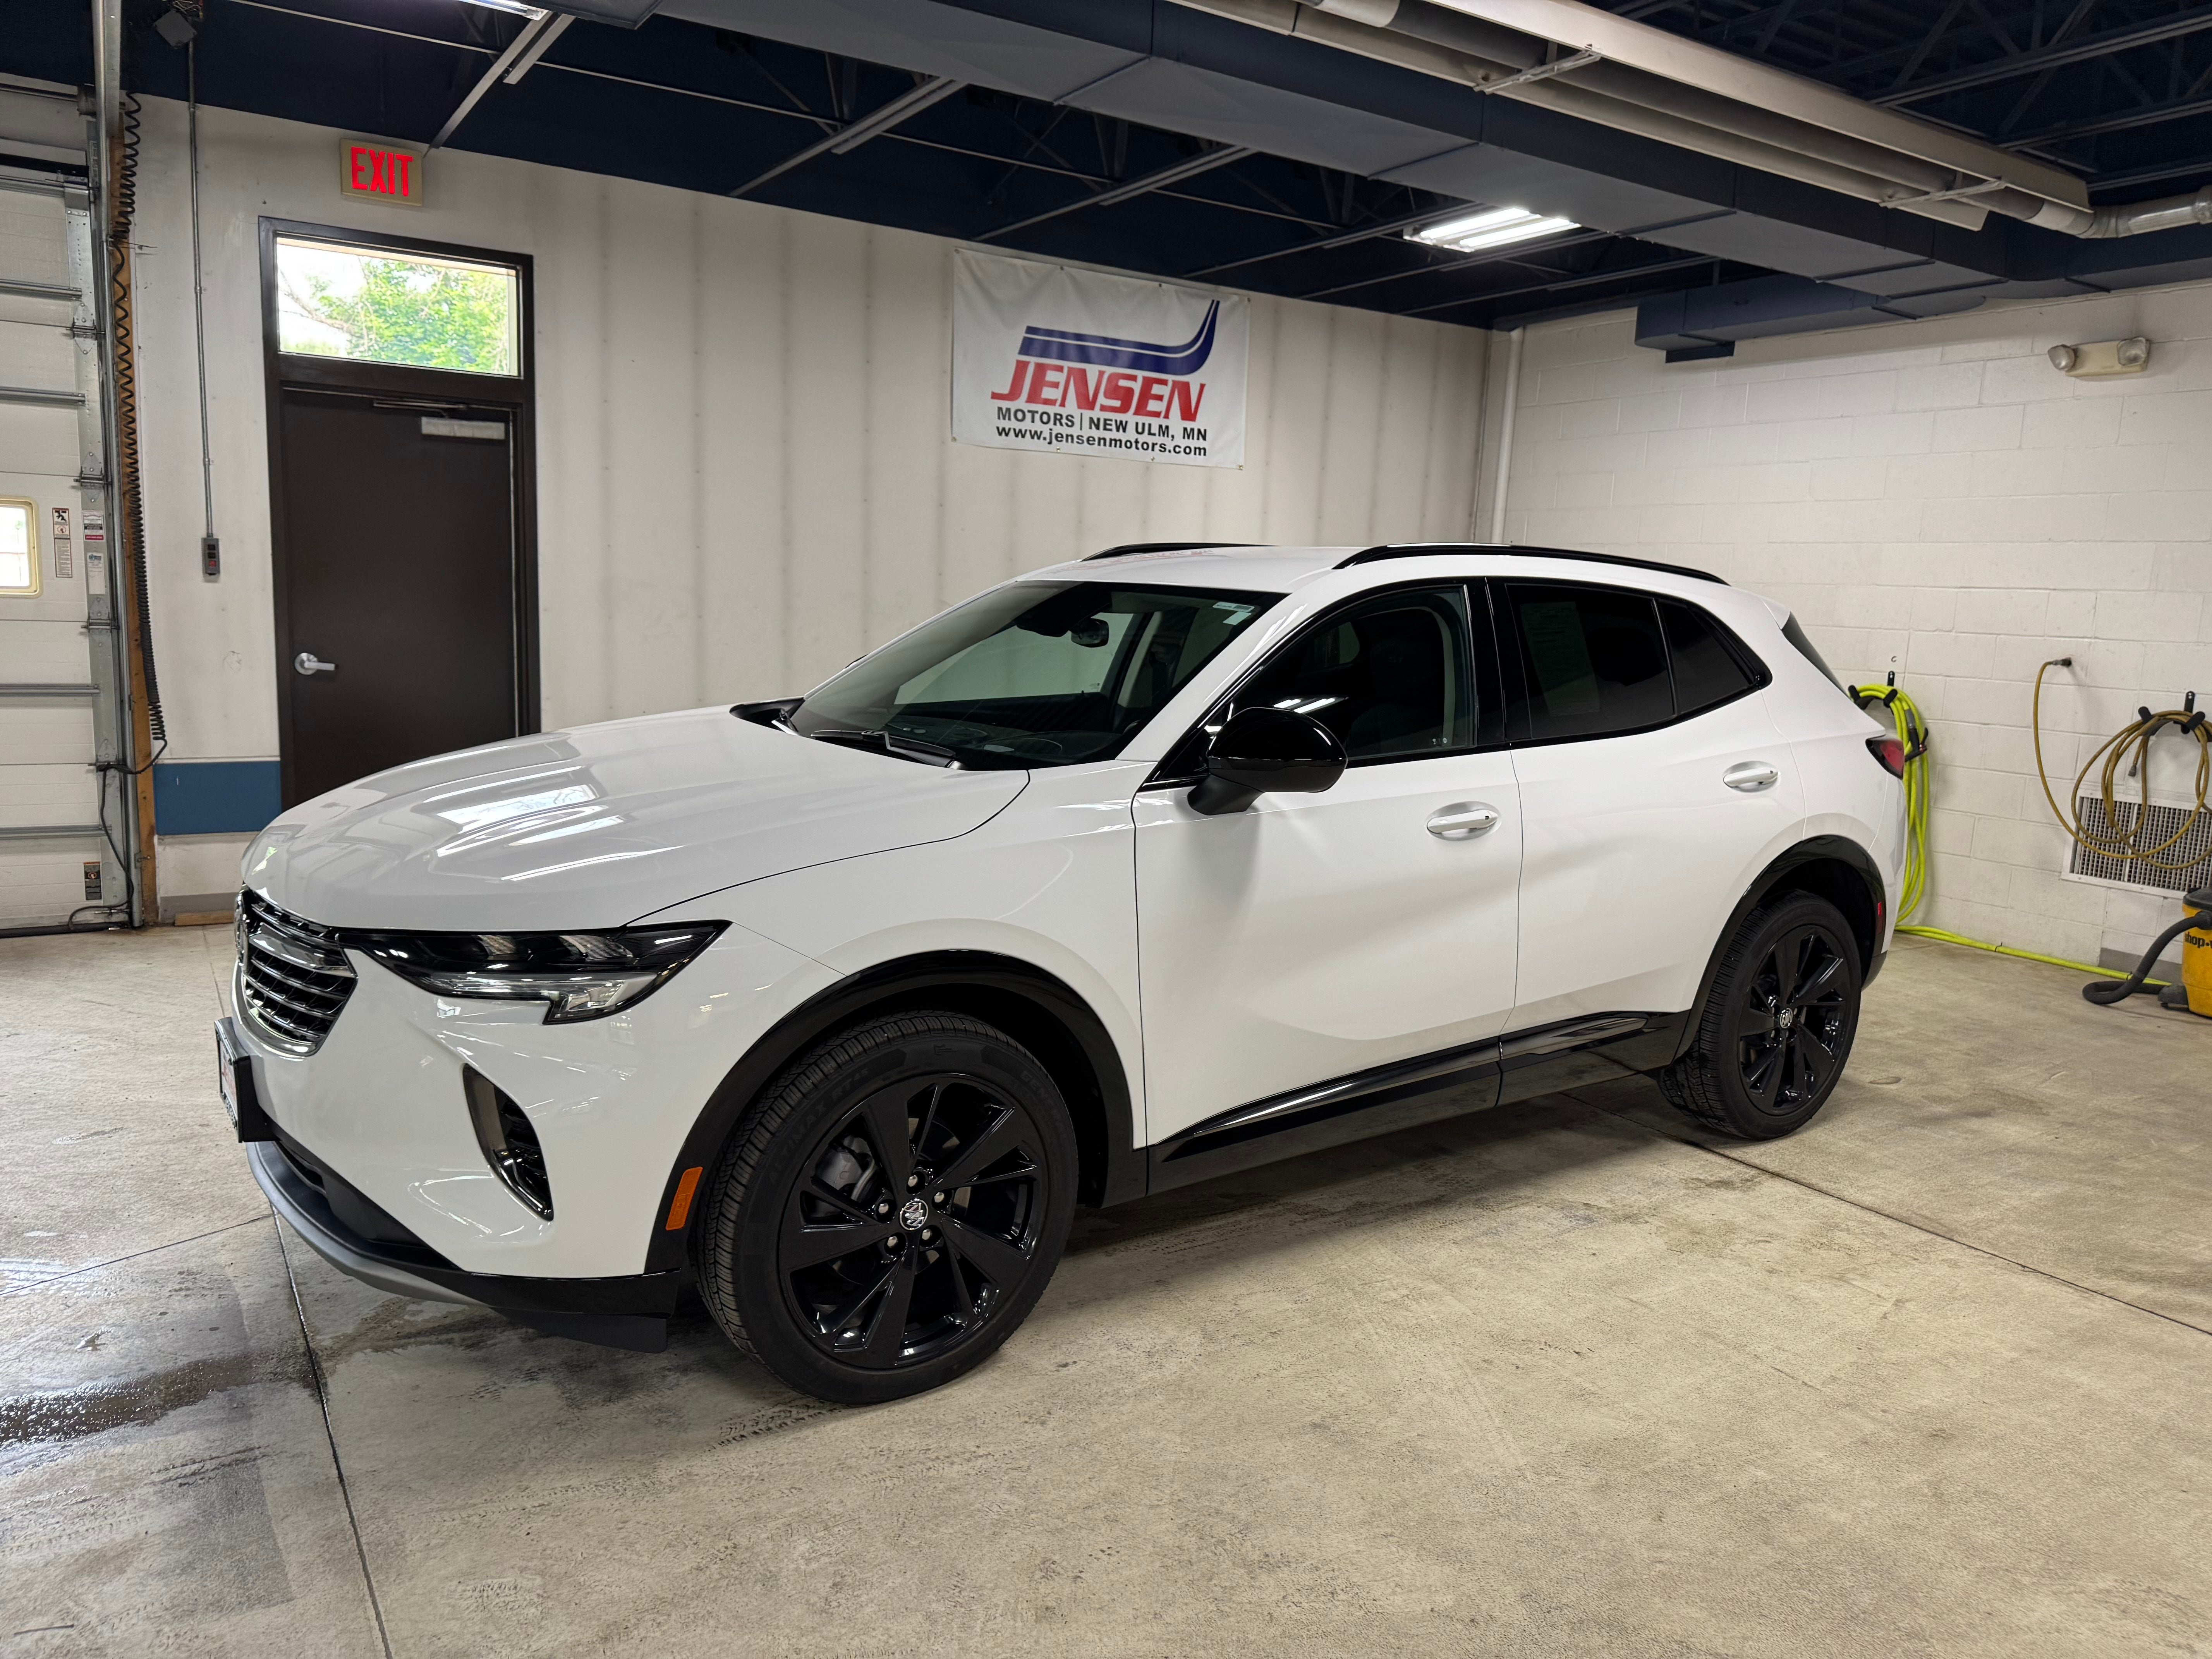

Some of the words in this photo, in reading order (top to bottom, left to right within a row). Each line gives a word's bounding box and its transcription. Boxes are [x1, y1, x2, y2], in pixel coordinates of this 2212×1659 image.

[351, 146, 413, 196] EXIT
[991, 359, 1206, 422] JENSEN
[996, 426, 1207, 456] www.jensenmotors.com
[997, 406, 1075, 428] MOTORS
[1089, 416, 1128, 433] NEW
[1135, 421, 1175, 441] ULM,
[1182, 426, 1207, 441] MN
